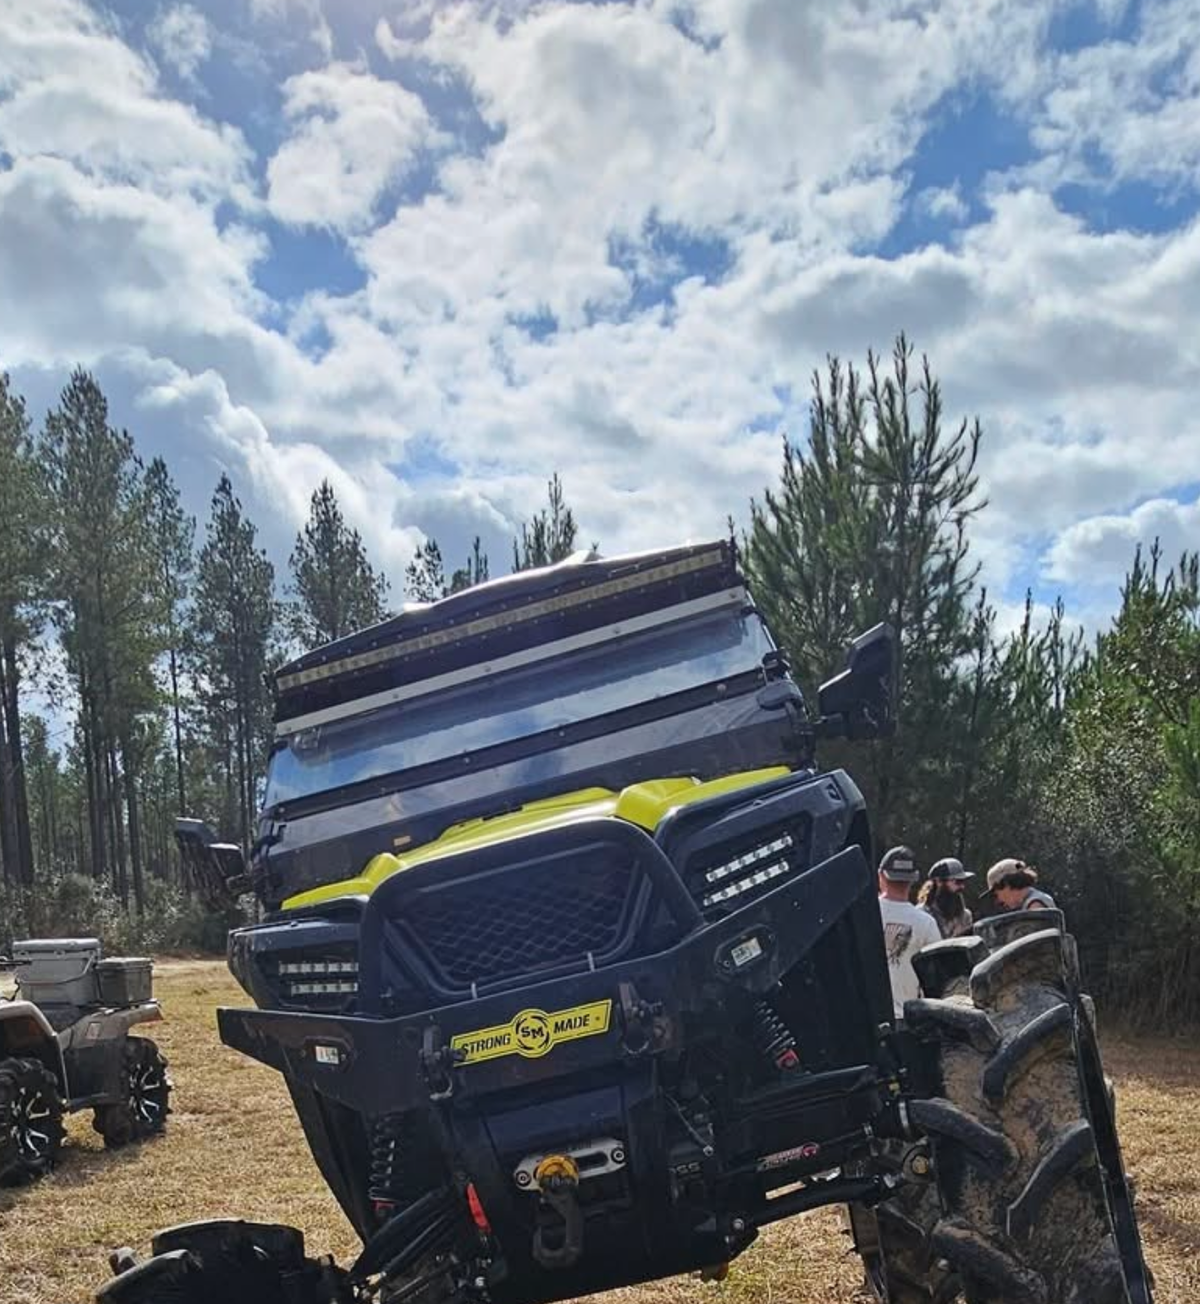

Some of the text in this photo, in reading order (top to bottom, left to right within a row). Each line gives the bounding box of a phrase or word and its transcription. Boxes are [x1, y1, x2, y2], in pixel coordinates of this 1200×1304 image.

[461, 1014, 590, 1056] STRONG SM MADE
